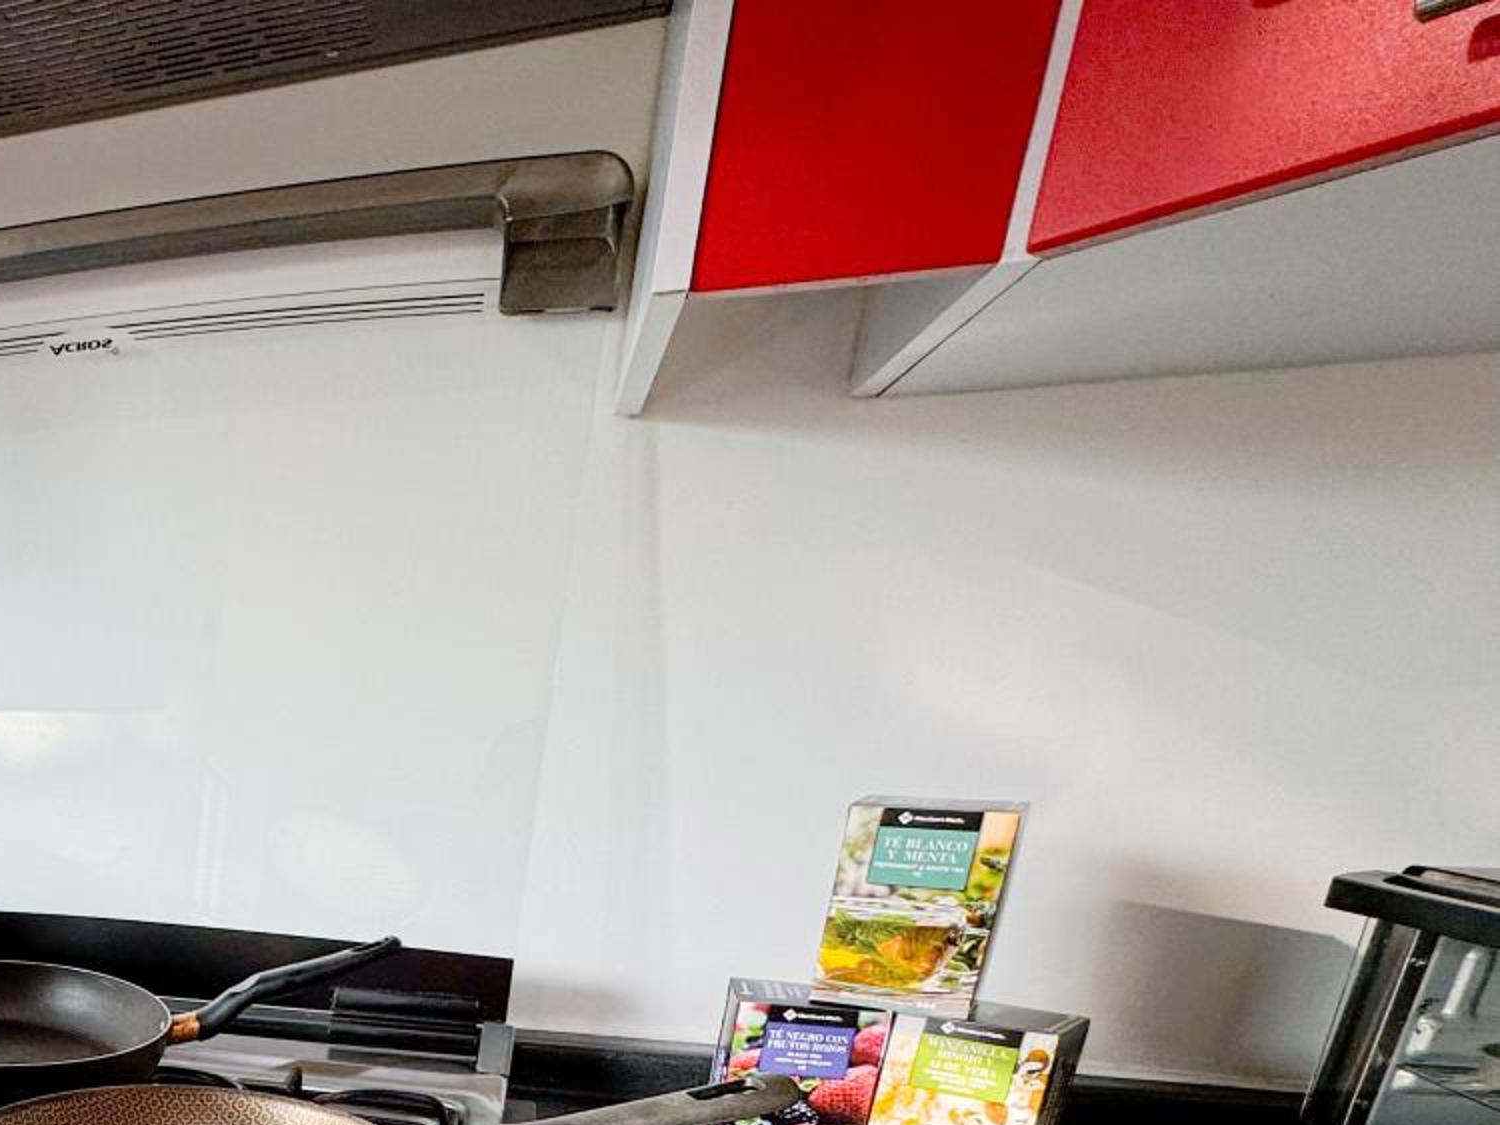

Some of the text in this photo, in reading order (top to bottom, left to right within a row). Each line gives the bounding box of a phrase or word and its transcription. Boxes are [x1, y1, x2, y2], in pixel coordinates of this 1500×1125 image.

[904, 837, 969, 852] BLANCO
[903, 850, 957, 865] MENTA
[786, 1030, 825, 1044] NEGRO
[825, 1034, 849, 1044] CON
